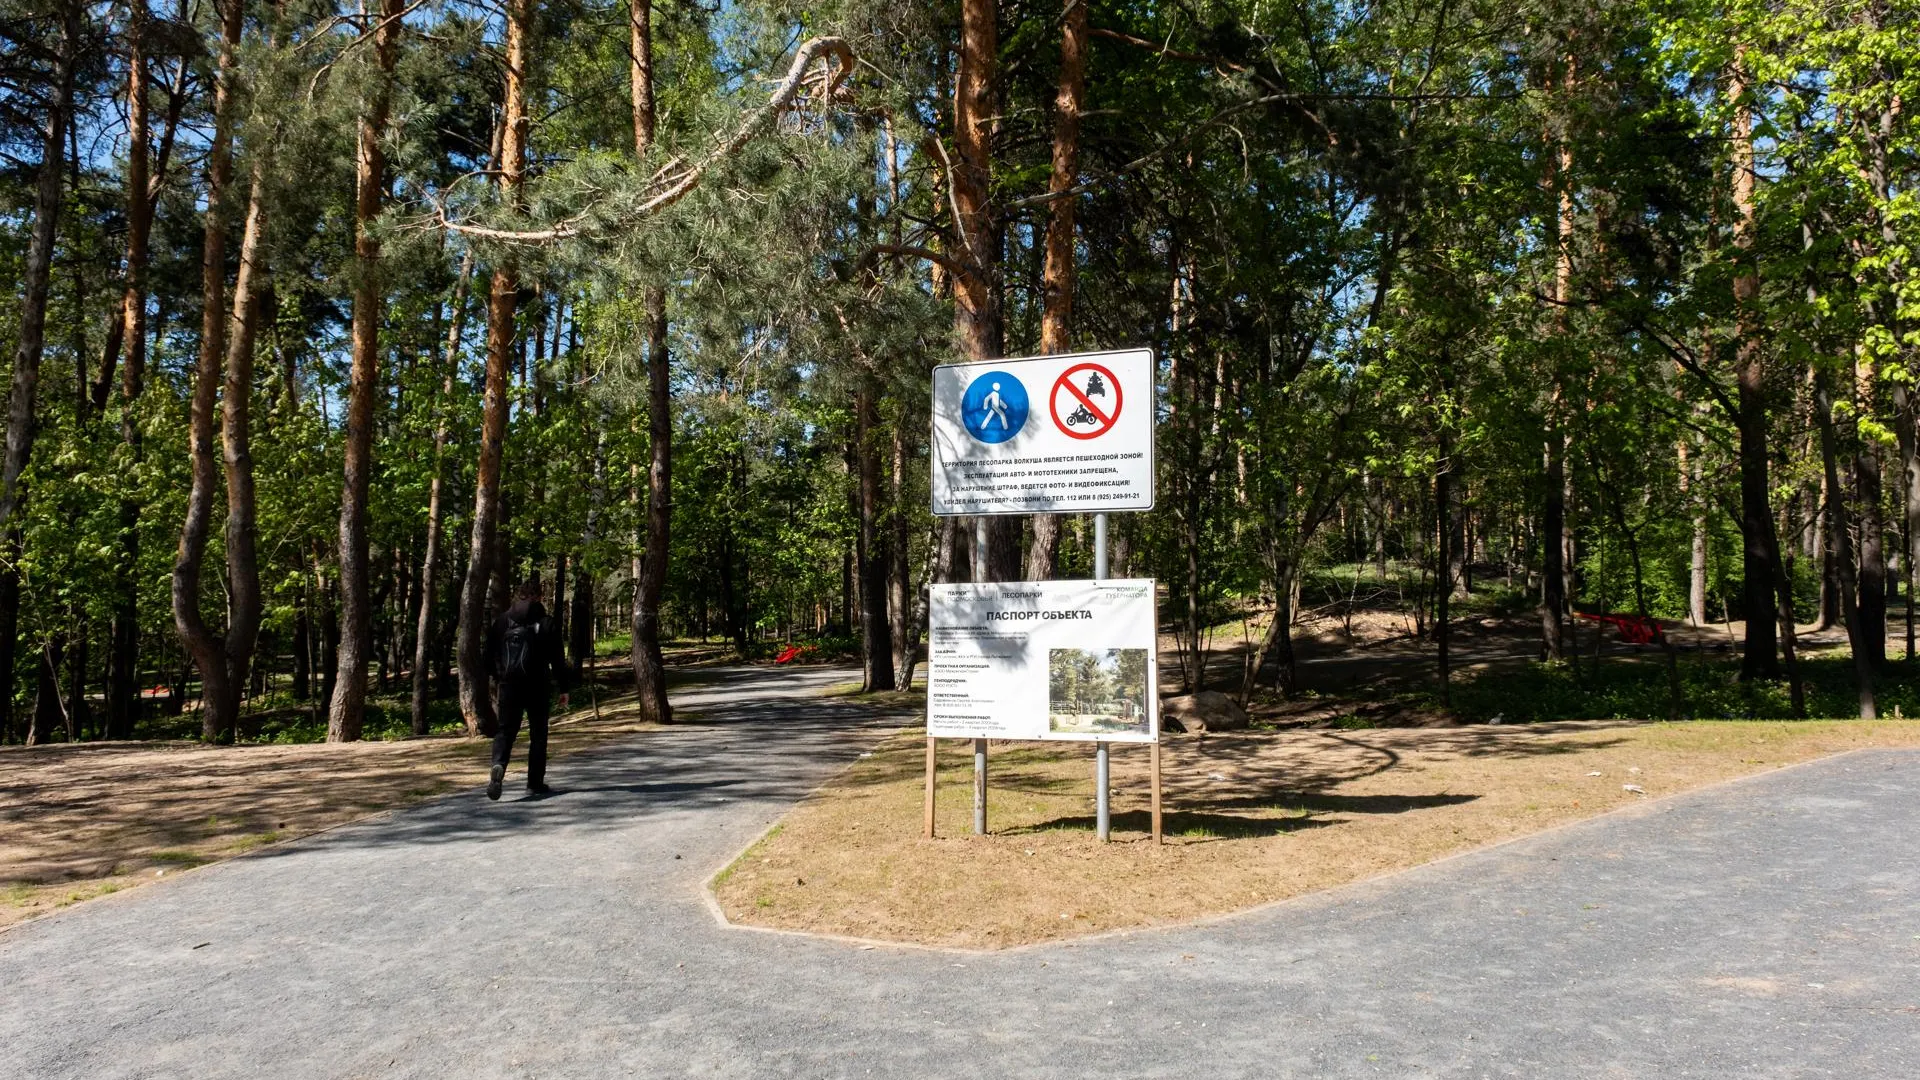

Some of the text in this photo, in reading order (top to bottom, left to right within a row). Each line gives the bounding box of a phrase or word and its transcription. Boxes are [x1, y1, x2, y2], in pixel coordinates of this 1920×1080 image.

[1076, 453, 1119, 461] ПЕШЕХОДНОЙ
[1120, 452, 1144, 460] ЗОНОЙ!
[1080, 467, 1119, 475] ЗАПРЕЩЕНА,
[1074, 480, 1130, 488] ВИДЕОФИКСАЦИЯ!
[1001, 591, 1042, 599] ЛЕСОПАРКИ
[986, 610, 1093, 621] ПАСПОРТ ОБЪЕКТА
